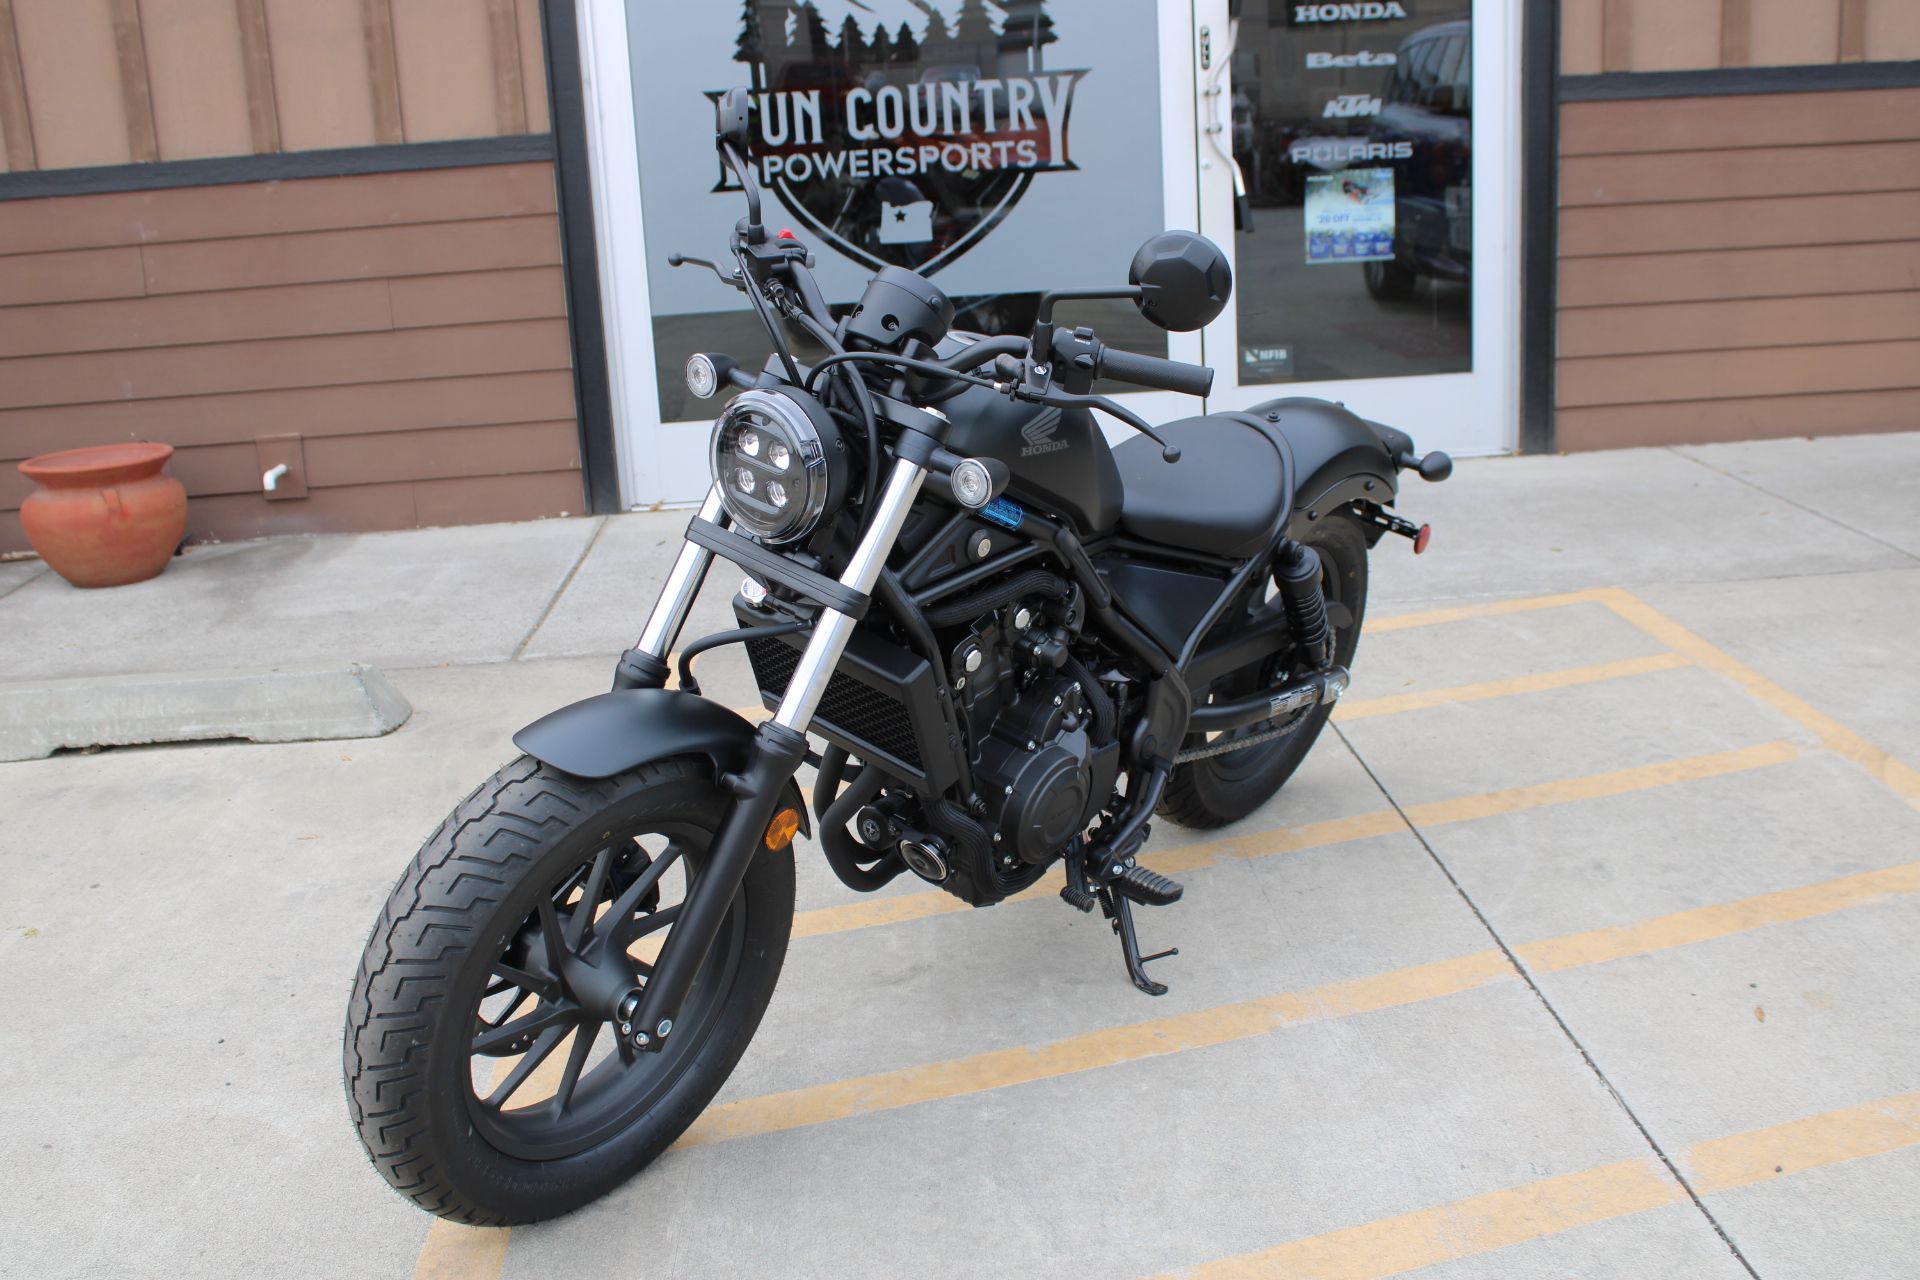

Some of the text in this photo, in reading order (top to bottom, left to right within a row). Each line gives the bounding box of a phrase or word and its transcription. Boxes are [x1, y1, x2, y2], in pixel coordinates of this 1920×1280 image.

[1294, 1, 1407, 23] HONDA
[1306, 50, 1397, 69] Beta
[1322, 94, 1382, 118] KTM
[846, 74, 1076, 167] COUNTRY
[763, 139, 1038, 184] POWERSPORTS
[1292, 141, 1414, 164] POLARIS
[1021, 440, 1069, 456] HONDA
